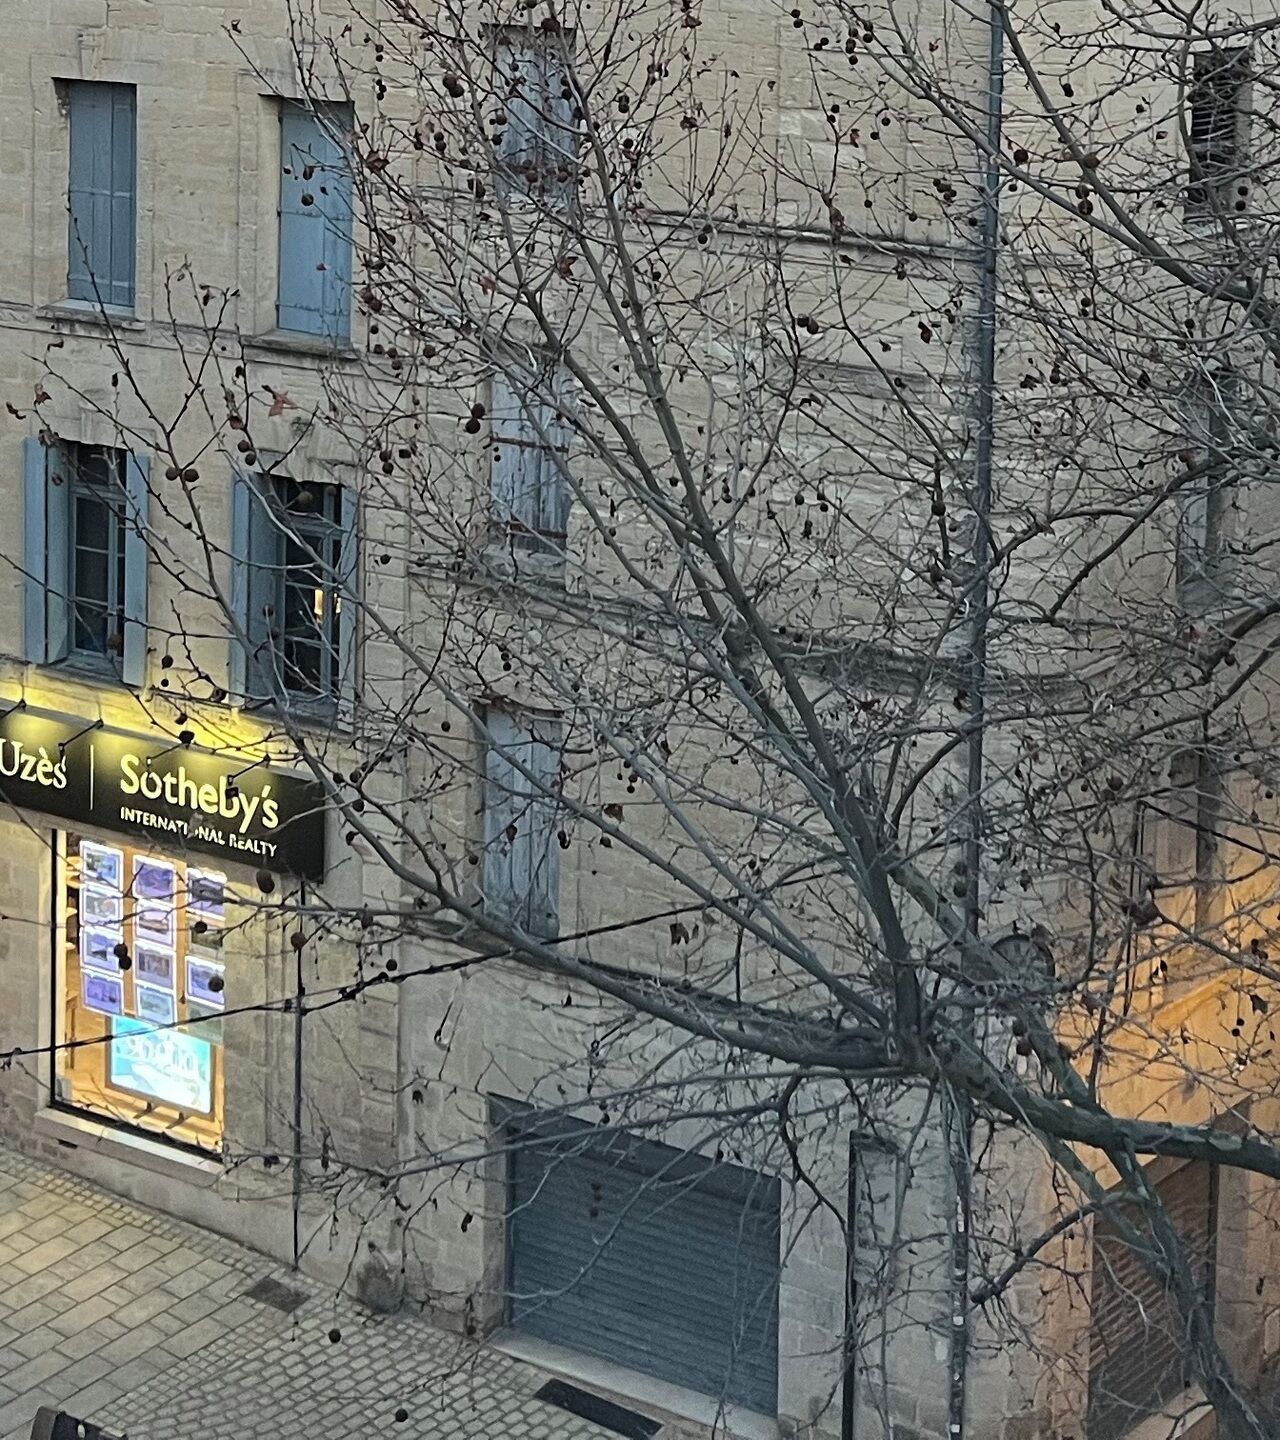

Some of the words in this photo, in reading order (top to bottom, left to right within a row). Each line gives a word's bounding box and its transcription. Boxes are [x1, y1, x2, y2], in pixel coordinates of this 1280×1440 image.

[120, 754, 280, 834] Sotheby's
[120, 806, 226, 846] INTERNATINAL
[229, 833, 278, 858] REALTY
